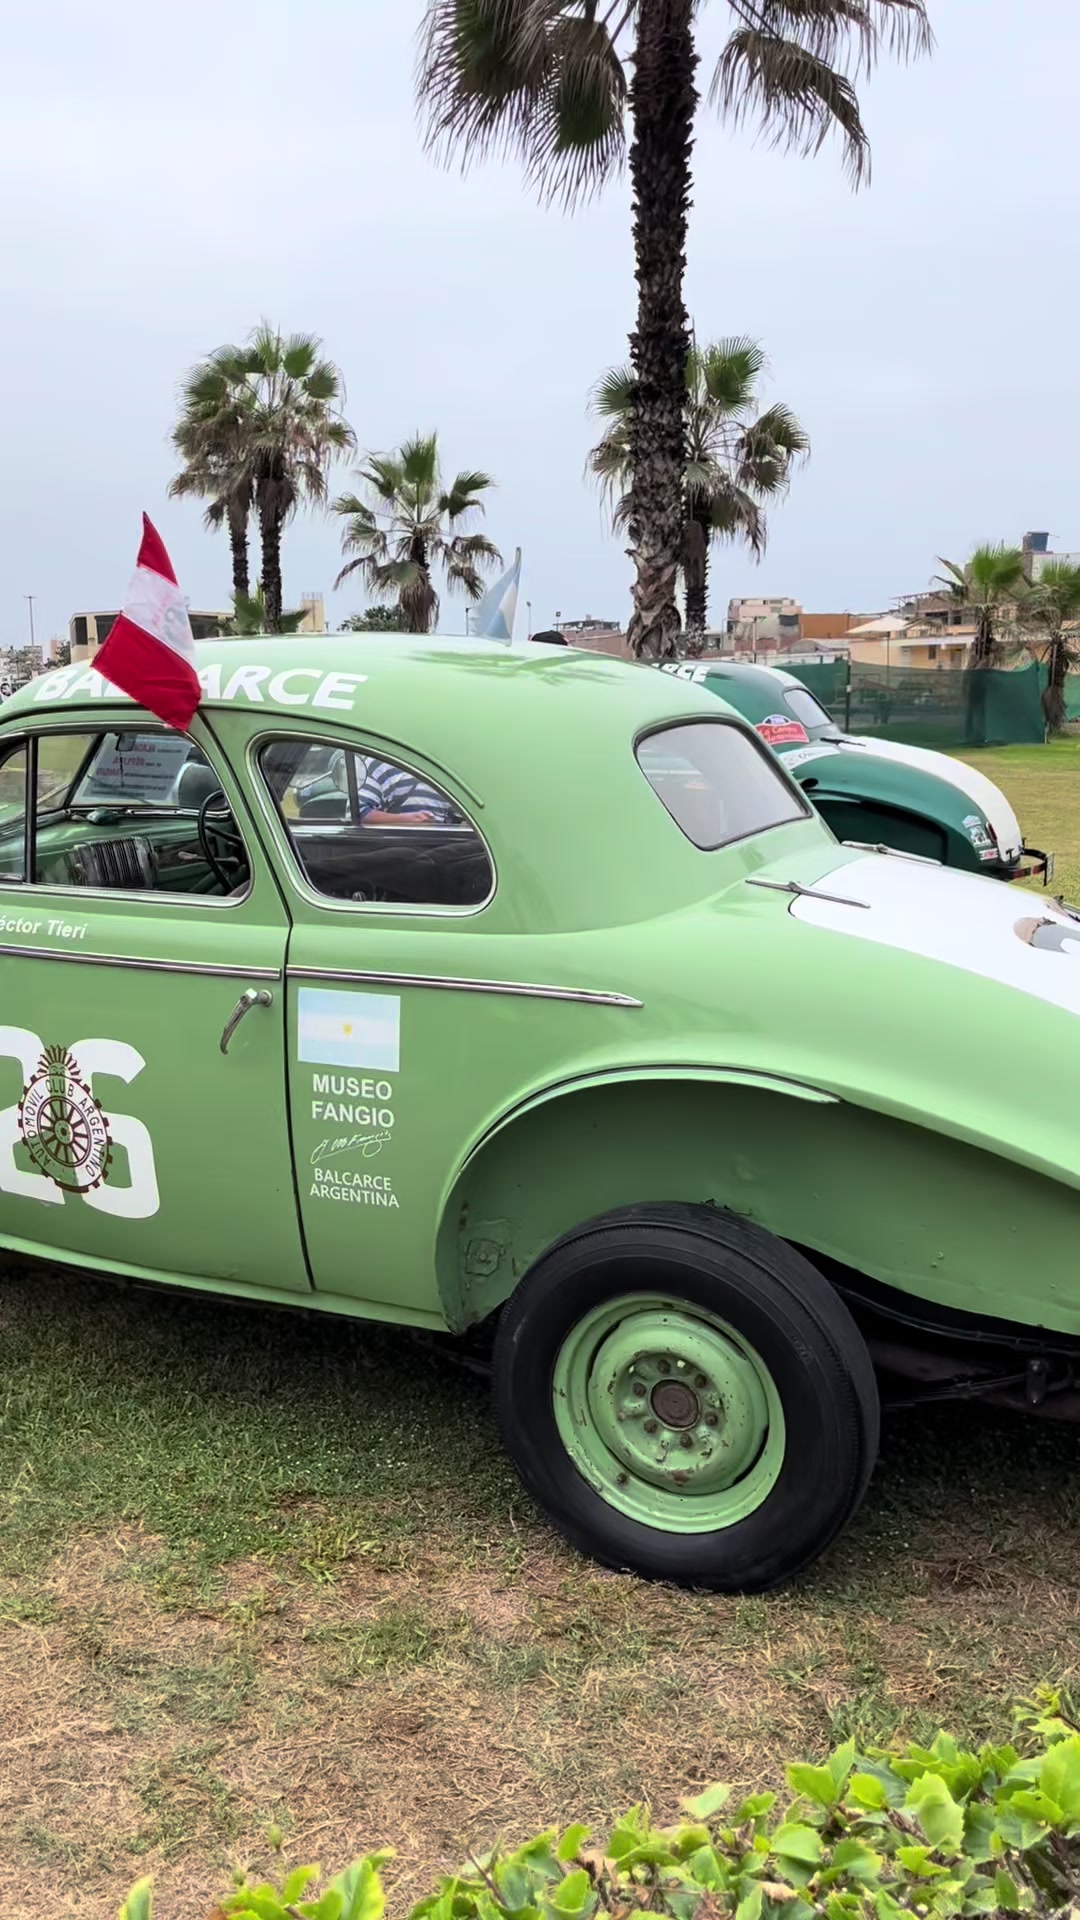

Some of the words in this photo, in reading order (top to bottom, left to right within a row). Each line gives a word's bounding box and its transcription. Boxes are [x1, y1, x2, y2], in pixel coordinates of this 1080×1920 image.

[47, 919, 88, 940] Tieri
[312, 1073, 392, 1100] MUSEO
[311, 1100, 394, 1128] FANGIO
[25, 1088, 52, 1167] AUTOMOVIL
[45, 1079, 74, 1097] CLUB
[78, 1098, 105, 1178] ARGENTINO
[314, 1167, 392, 1191] BALCARCE
[310, 1183, 400, 1209] ARGENTINA
